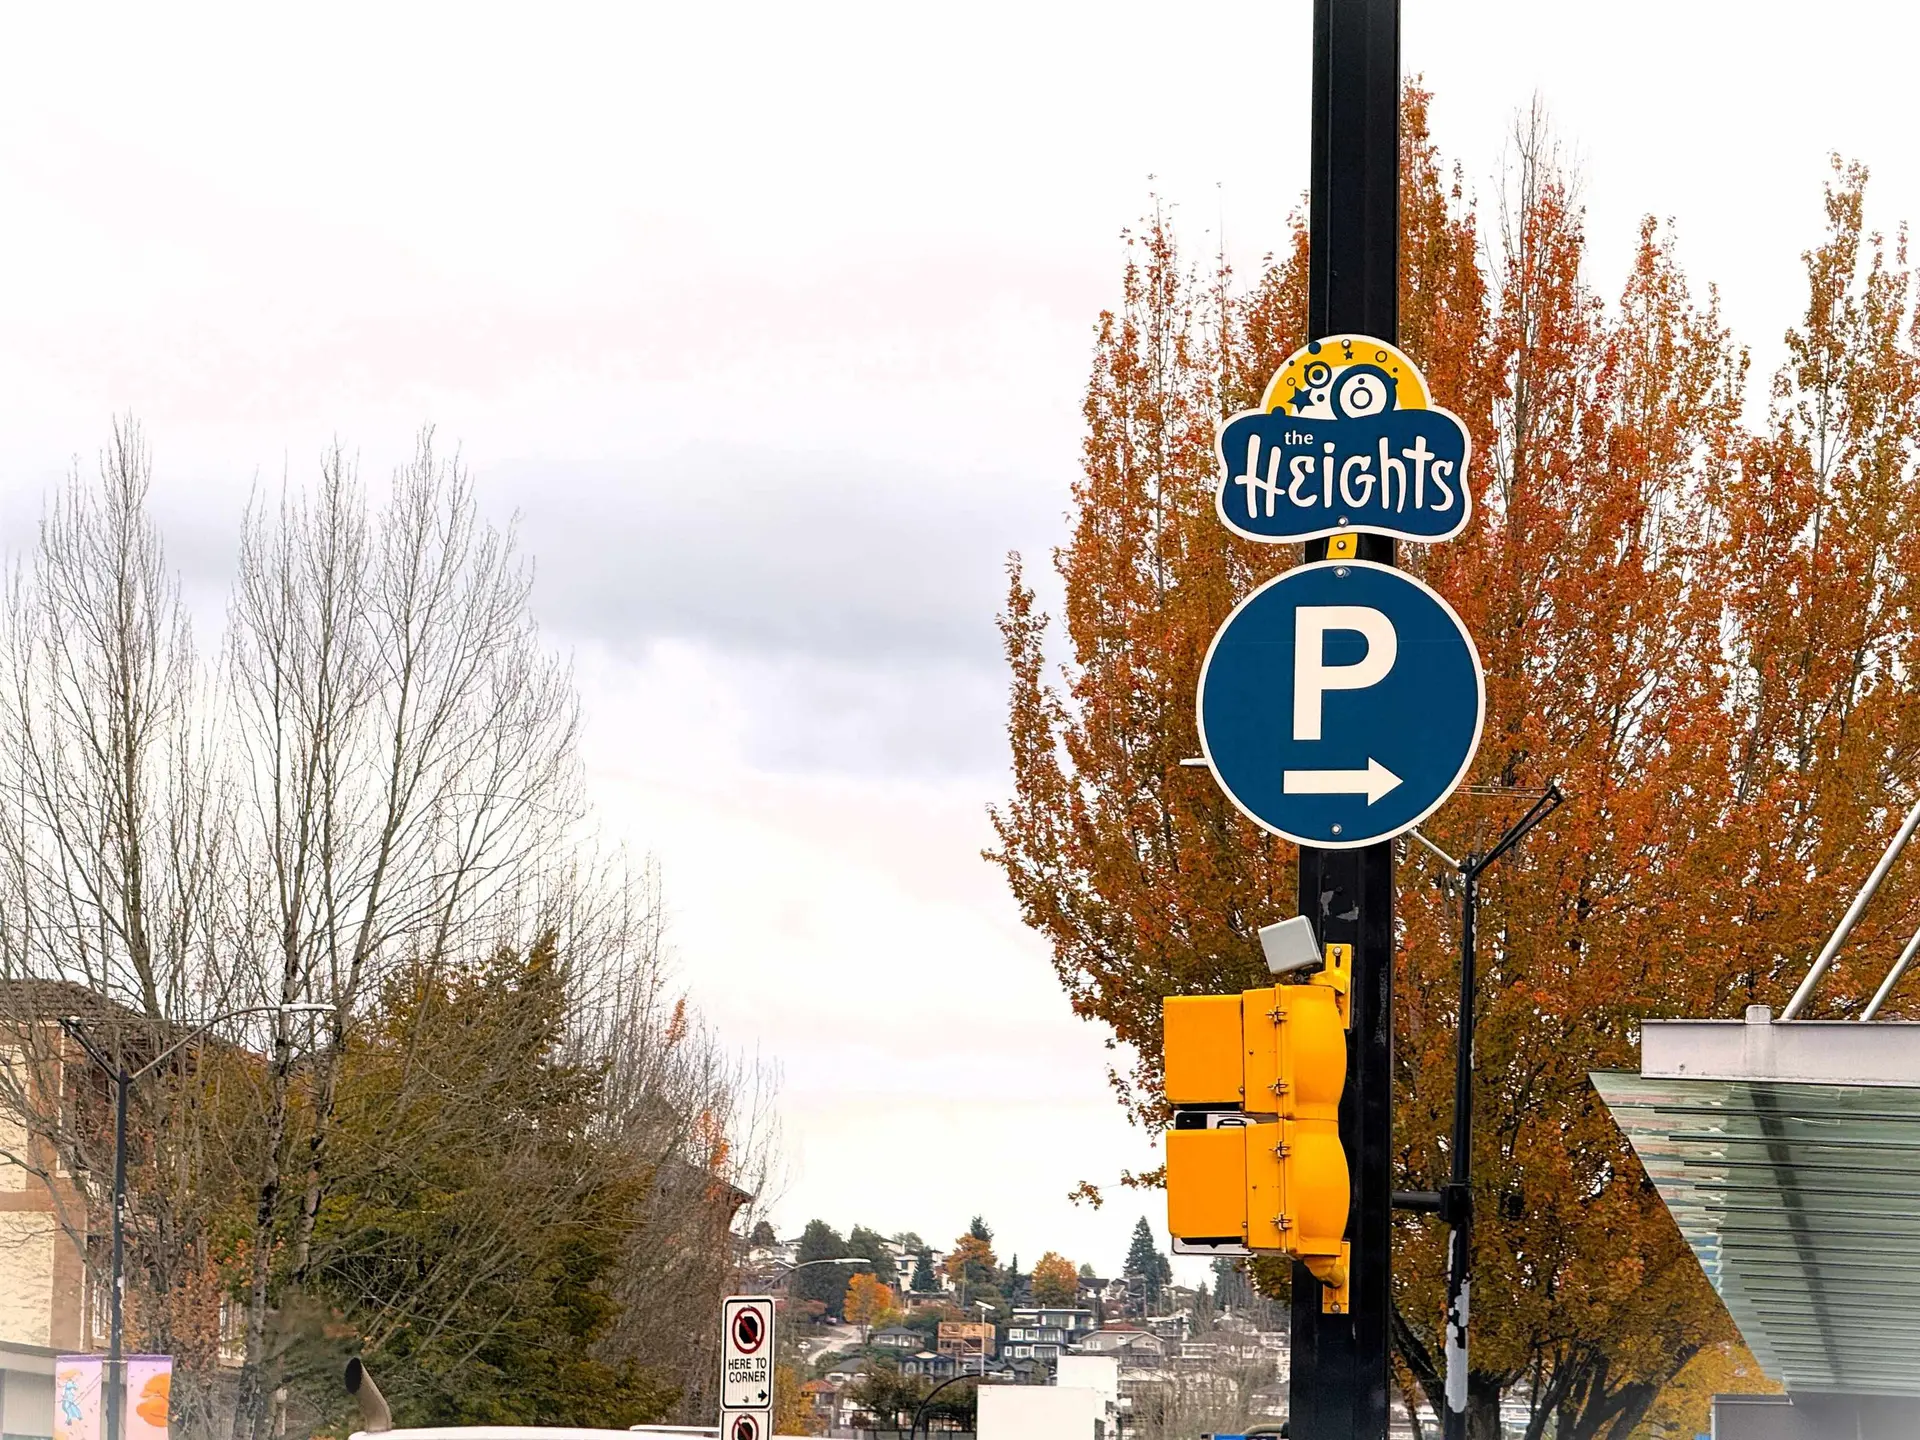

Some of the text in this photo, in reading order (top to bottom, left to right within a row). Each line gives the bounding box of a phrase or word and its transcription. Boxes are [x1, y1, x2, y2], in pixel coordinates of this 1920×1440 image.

[1284, 430, 1314, 446] the
[1293, 605, 1398, 741] P
[728, 1358, 767, 1370] HERE TO
[729, 1371, 766, 1383] CORNER
